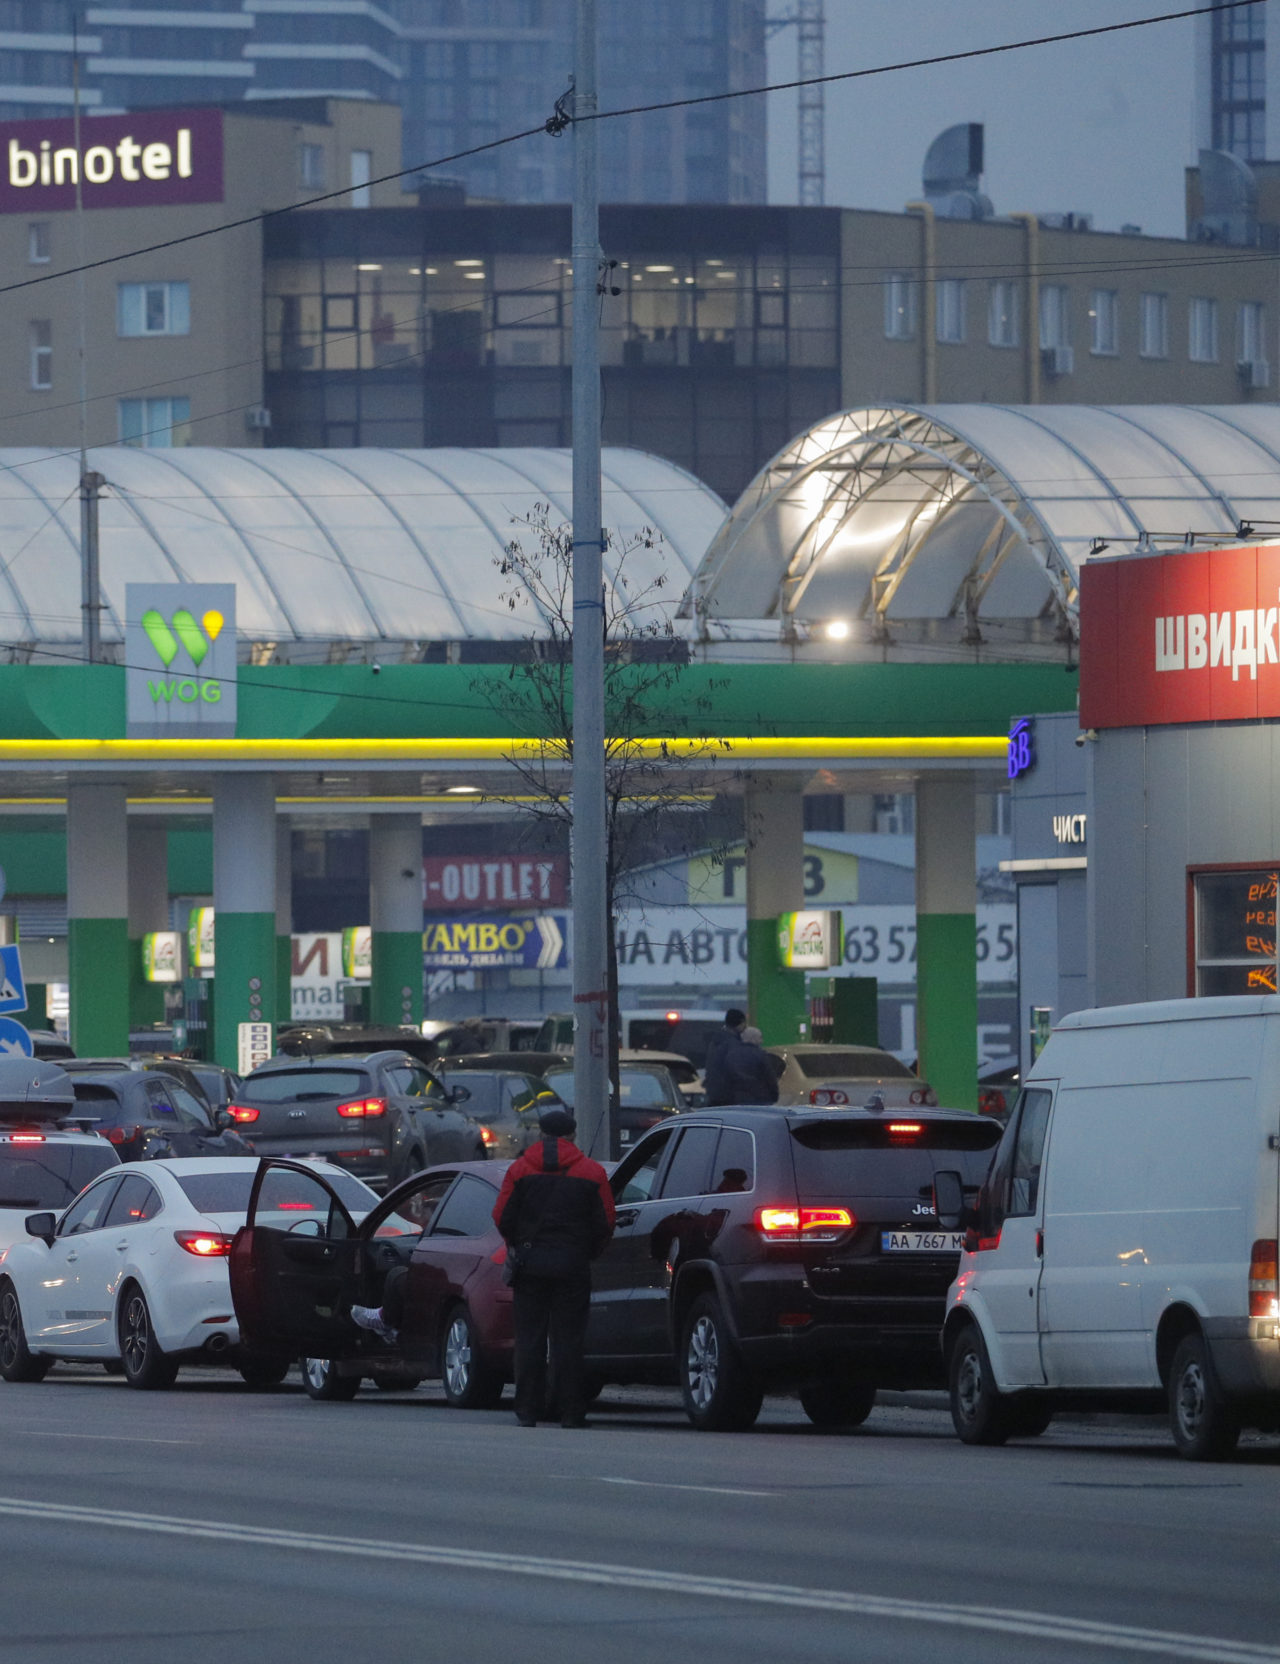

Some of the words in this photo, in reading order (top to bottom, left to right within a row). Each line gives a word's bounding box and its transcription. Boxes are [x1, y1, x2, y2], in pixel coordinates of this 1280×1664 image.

[9, 129, 192, 187] binotel
[1156, 606, 1280, 682] ШВИДК
[147, 680, 221, 703] WOG
[1053, 815, 1087, 843] ЧИСТ
[422, 863, 554, 901] -OUTLET
[723, 855, 825, 897] ГЗ
[911, 1203, 936, 1216] Jee
[890, 1234, 910, 1249] AA
[915, 1234, 946, 1249] 7667
[952, 1234, 966, 1249] M
